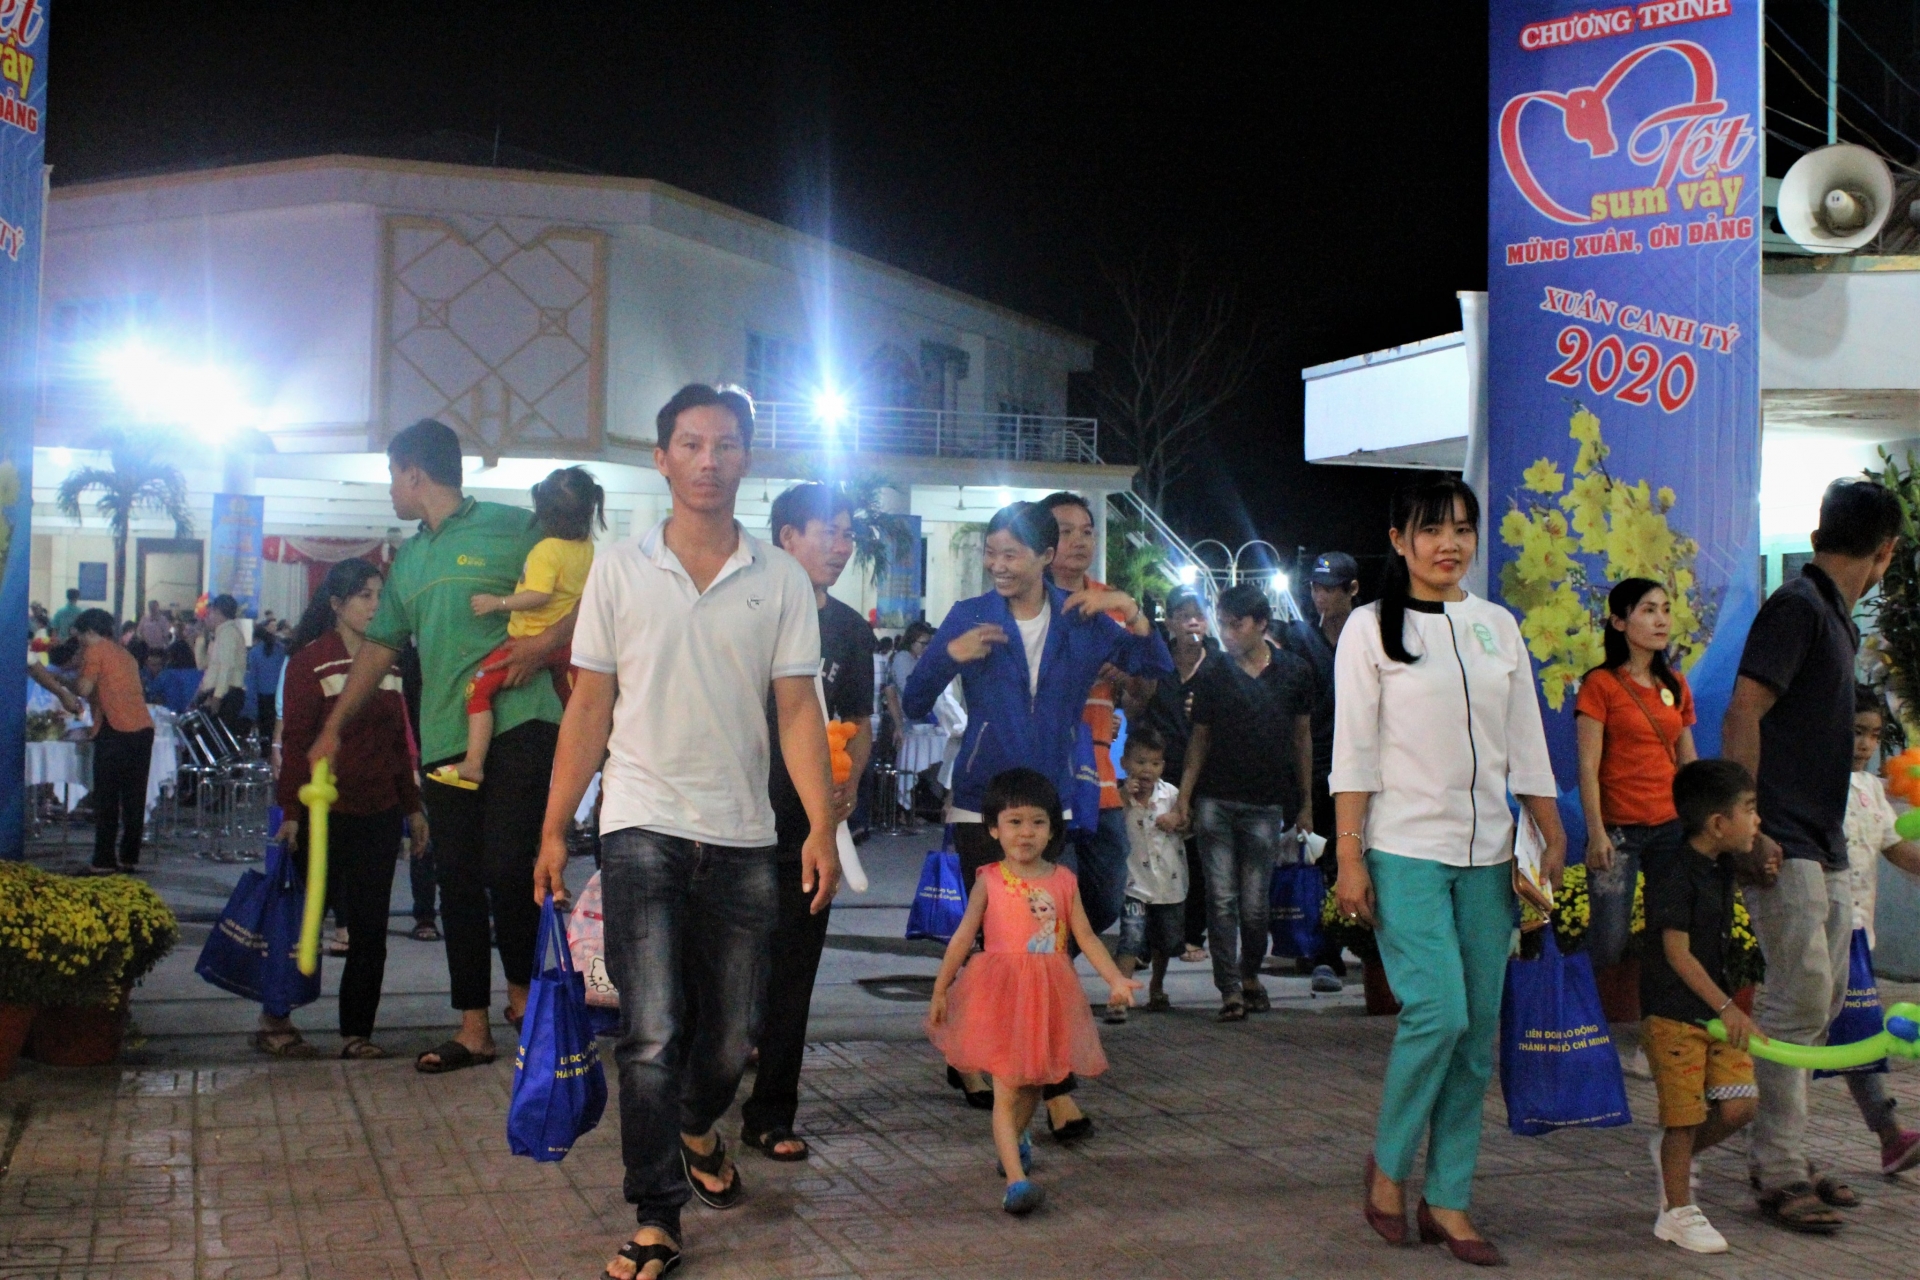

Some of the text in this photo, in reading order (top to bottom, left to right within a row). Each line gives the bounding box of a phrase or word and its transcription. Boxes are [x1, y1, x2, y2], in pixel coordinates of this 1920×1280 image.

[1520, 10, 1632, 49] CHƯƠNG
[0, 27, 34, 100] ầy
[0, 87, 38, 134] ẢNG
[1628, 101, 1757, 190] Tết
[1591, 163, 1744, 222] sum vầy
[1506, 210, 1753, 267] MỪNG XUÂN, ƠN ĐẢNG
[1540, 286, 1740, 354] XUÂN CANH TÝ
[1546, 325, 1698, 414] 2020
[1572, 1037, 1588, 1050] CHÍ
[1588, 1035, 1610, 1048] MINH
